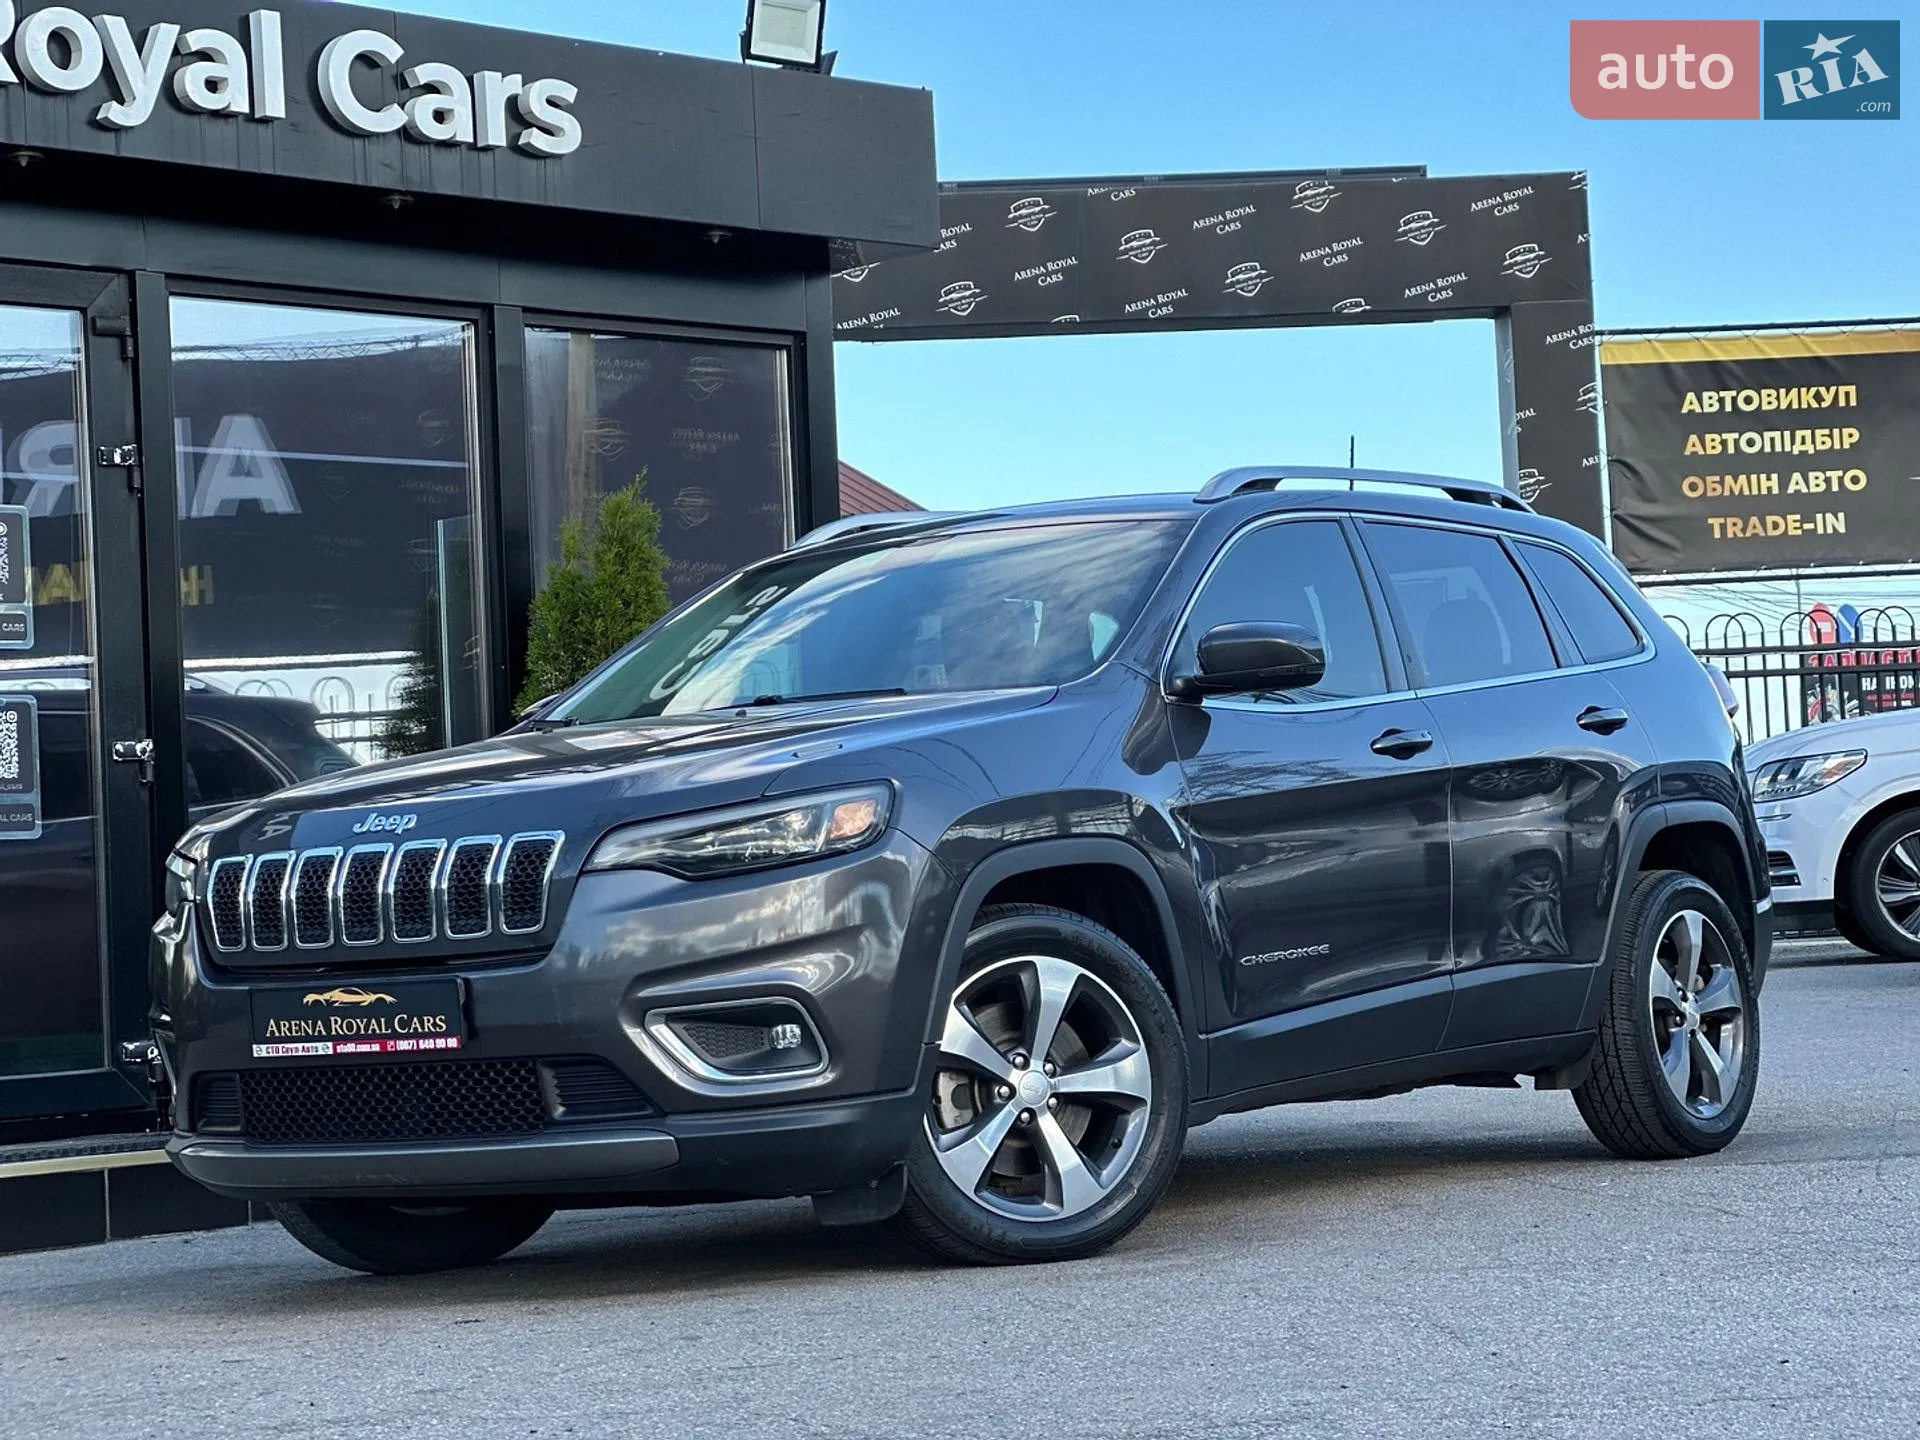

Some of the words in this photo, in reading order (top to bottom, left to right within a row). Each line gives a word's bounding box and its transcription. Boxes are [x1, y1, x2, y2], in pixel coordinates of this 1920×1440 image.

[318, 29, 582, 154] Cars
[1110, 187, 1137, 201] CARS
[1470, 196, 1502, 212] ARENA
[1503, 186, 1535, 201] ROYAL
[1193, 214, 1224, 230] ARENA
[1225, 205, 1257, 220] ROYAL
[1494, 203, 1520, 217] CARS
[940, 222, 973, 238] ROYAL
[1215, 221, 1242, 235] CARS
[934, 239, 957, 253] ARS
[1300, 246, 1331, 262] ARENA
[1332, 237, 1364, 252] ROYAL
[1014, 265, 1046, 281] ARENA
[1047, 256, 1078, 271] ROYAL
[1323, 254, 1349, 267] CARS
[1038, 273, 1064, 287] CARS
[1404, 281, 1436, 298] ARENA
[1437, 272, 1468, 288] ROYAL
[1124, 298, 1156, 313] ARENA
[1157, 288, 1188, 303] ROYAL
[1428, 288, 1453, 302] CARS
[869, 307, 901, 322] ROYAL
[1148, 305, 1174, 319] CARS
[1545, 329, 1577, 345] ARENA
[1681, 385, 1858, 413] АВТОВИКУП
[1684, 428, 1860, 455] АВТОПІДБІР
[1682, 473, 1779, 498] ОБМІН
[1787, 469, 1867, 495] АВТО
[1707, 512, 1846, 539] TRADE-IN
[353, 812, 418, 834] Jeep
[1240, 943, 1330, 966] CHEROKEE
[266, 1018, 327, 1038] ARENA
[329, 1016, 392, 1036] ROYAL
[394, 1014, 447, 1033] CARS
